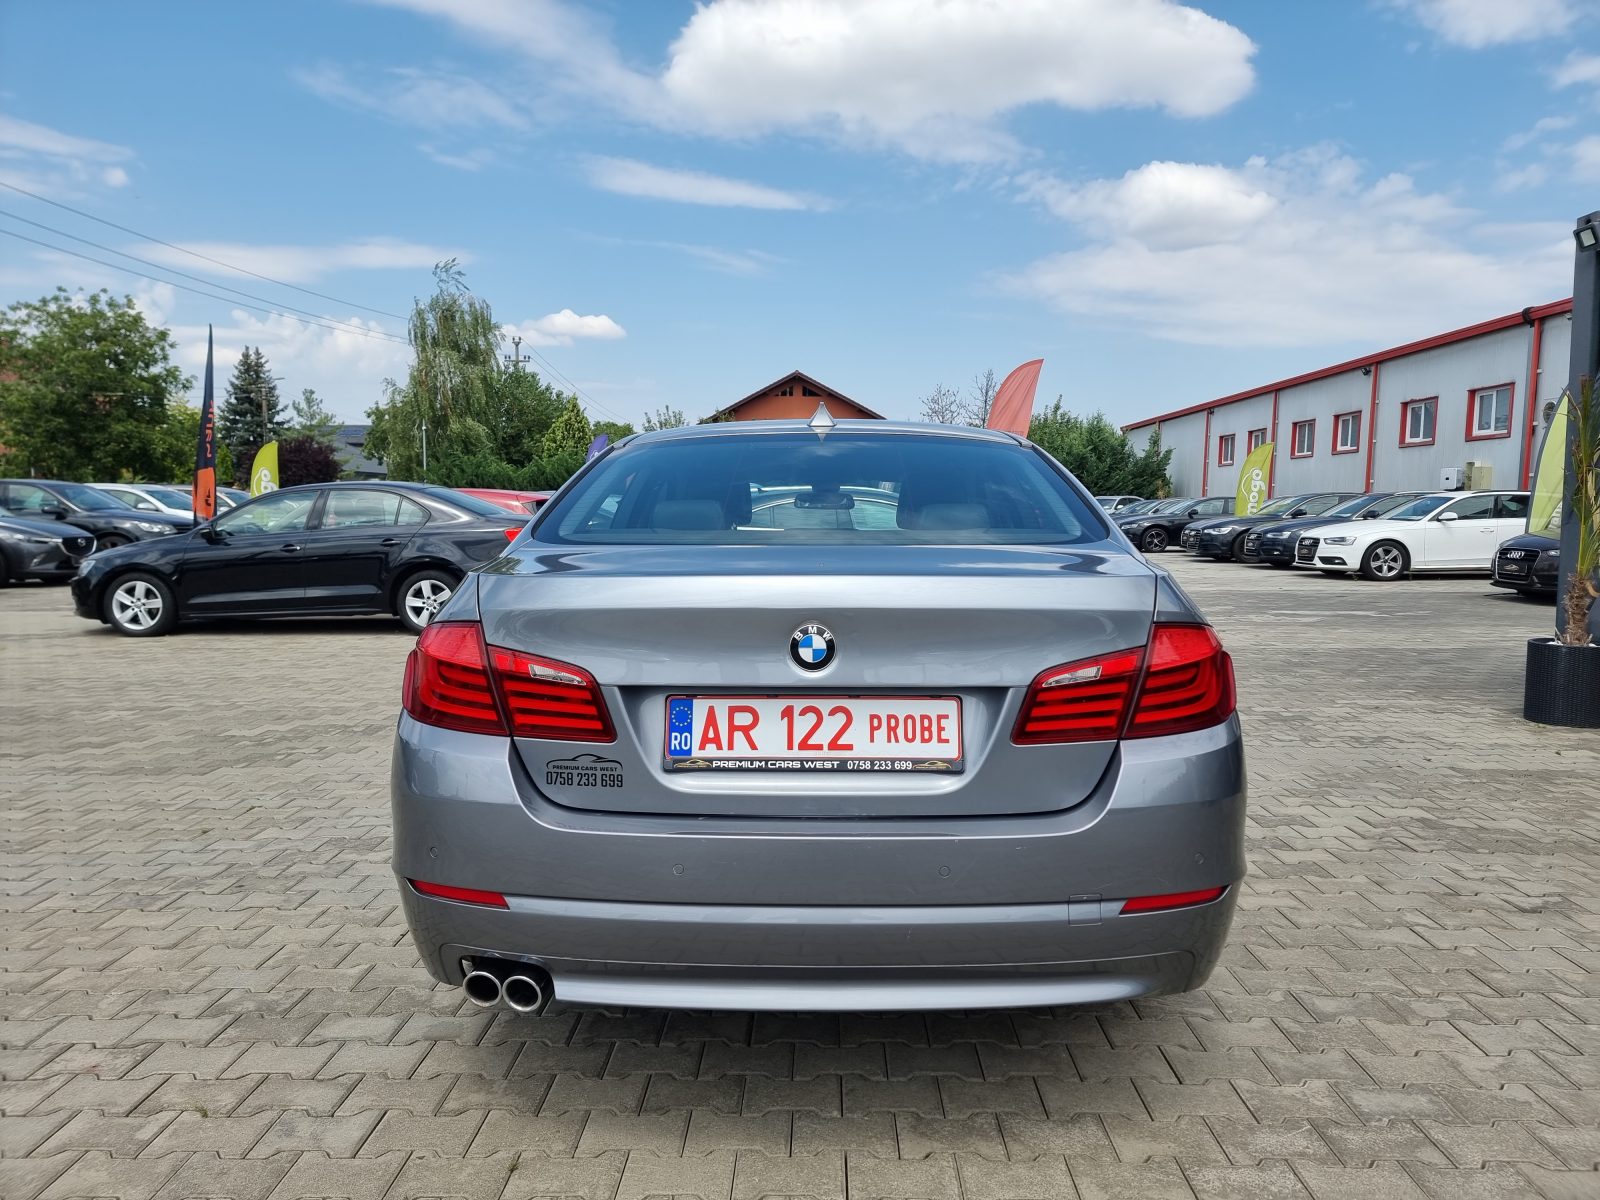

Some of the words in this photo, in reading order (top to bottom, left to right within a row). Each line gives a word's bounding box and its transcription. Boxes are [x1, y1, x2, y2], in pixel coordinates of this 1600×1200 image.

[793, 626, 832, 642] BMW
[698, 705, 760, 751] AR
[780, 705, 854, 751] 122
[868, 713, 950, 744] PROBE
[671, 732, 691, 750] RO
[712, 760, 764, 768] PREMIUM
[768, 760, 801, 768] CARS
[803, 761, 840, 769] WEST
[847, 760, 871, 770] 0758
[873, 761, 892, 770] 233
[894, 761, 913, 770] 699
[546, 771, 574, 786] 0758
[576, 773, 597, 787] 233
[600, 773, 623, 788] 699
